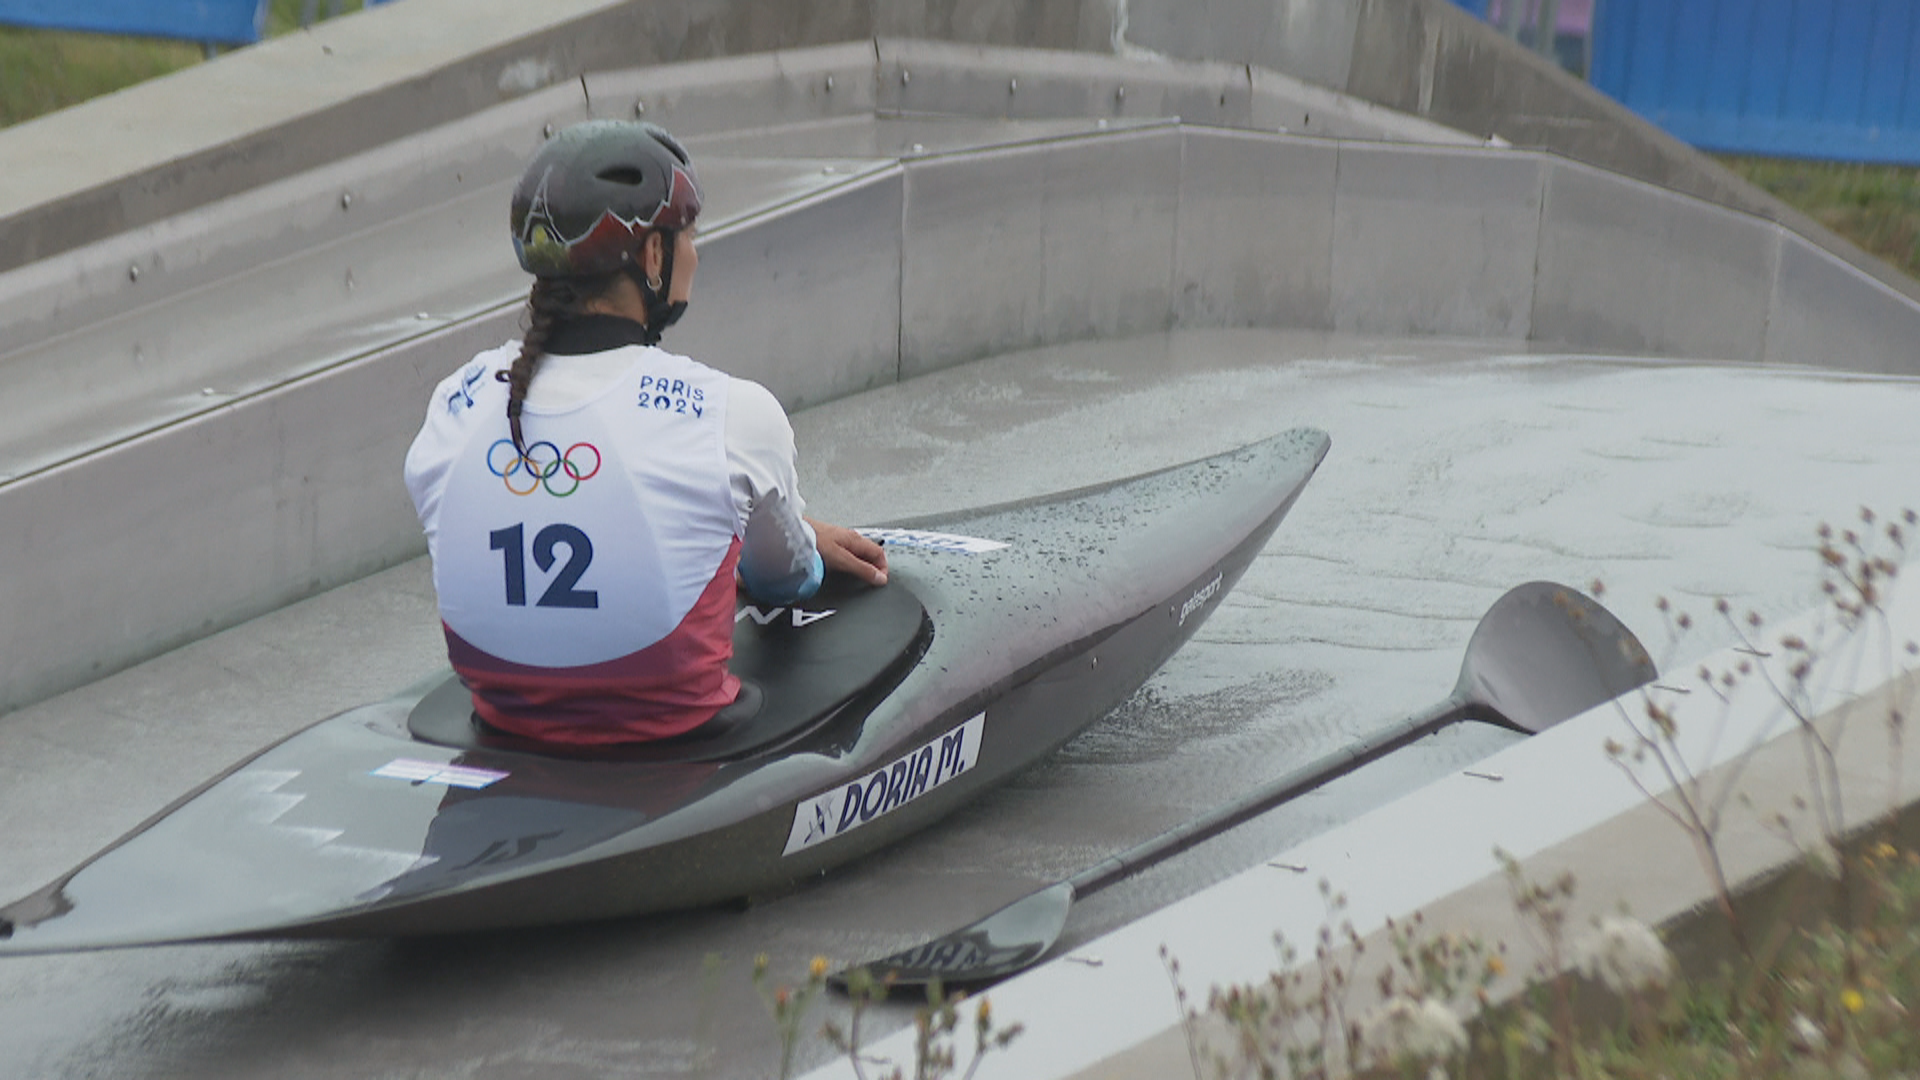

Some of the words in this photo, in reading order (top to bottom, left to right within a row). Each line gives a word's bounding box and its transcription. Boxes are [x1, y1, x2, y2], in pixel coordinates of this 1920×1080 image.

[638, 391, 702, 418] 2024
[640, 375, 703, 401] PARIS
[489, 522, 599, 609] 12
[836, 745, 933, 834] DORIA
[932, 726, 966, 786] M.
